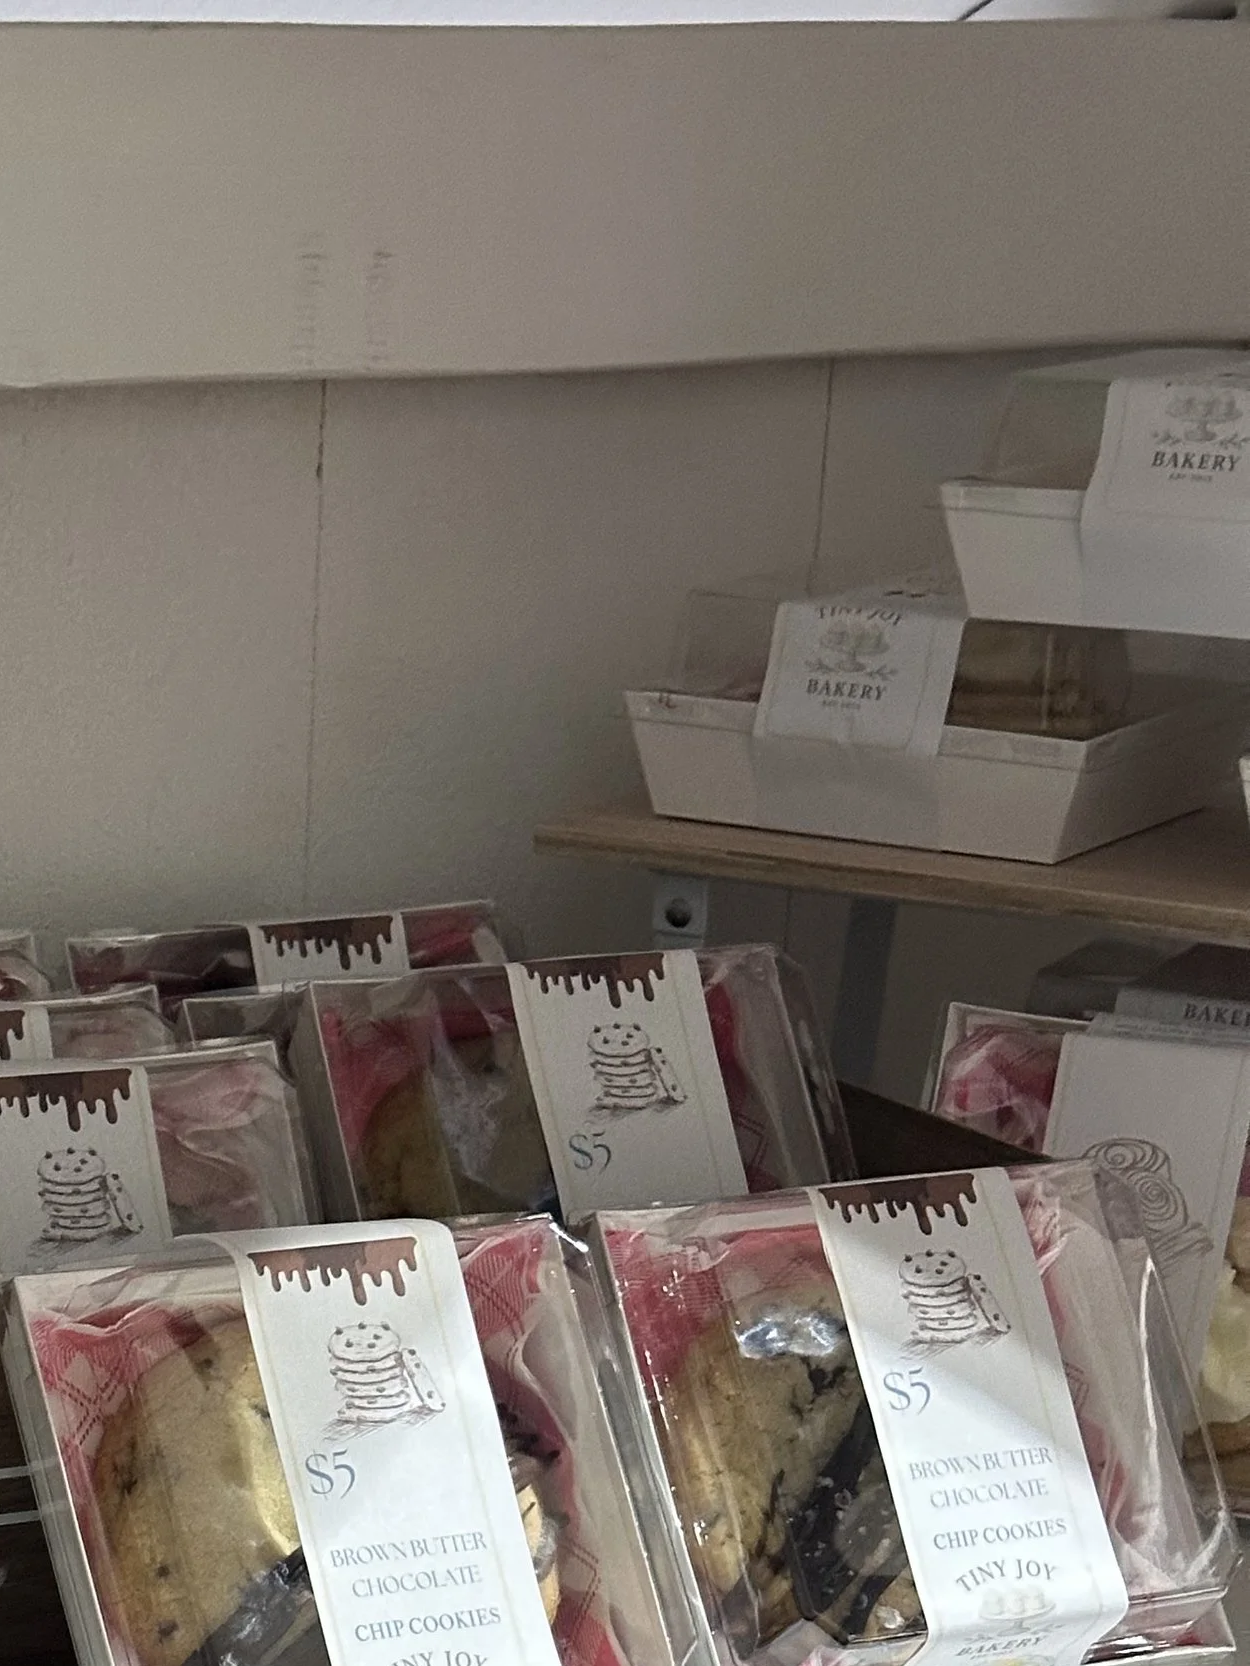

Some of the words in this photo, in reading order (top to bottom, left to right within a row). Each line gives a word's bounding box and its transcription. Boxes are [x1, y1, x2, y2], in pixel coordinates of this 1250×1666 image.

[1151, 450, 1241, 471] BAKERY
[806, 678, 888, 701] BAKERY
[882, 1365, 932, 1417] $5
[304, 1448, 356, 1501] $5
[908, 1454, 981, 1481] BROWN
[982, 1446, 1054, 1472] BUTTER
[929, 1477, 1050, 1509] CHOCOLATE
[329, 1542, 407, 1569] BROWN
[408, 1530, 487, 1558] BUTTER
[932, 1528, 979, 1551] CHIP
[982, 1517, 1068, 1545] COOKIES
[351, 1564, 483, 1599] CHOCOLATE
[955, 1559, 1006, 1593] TINY
[1015, 1557, 1058, 1581] JOY
[354, 1618, 404, 1643] CHIP
[407, 1606, 502, 1636] COOKIES
[954, 1634, 1047, 1657] BAKERY
